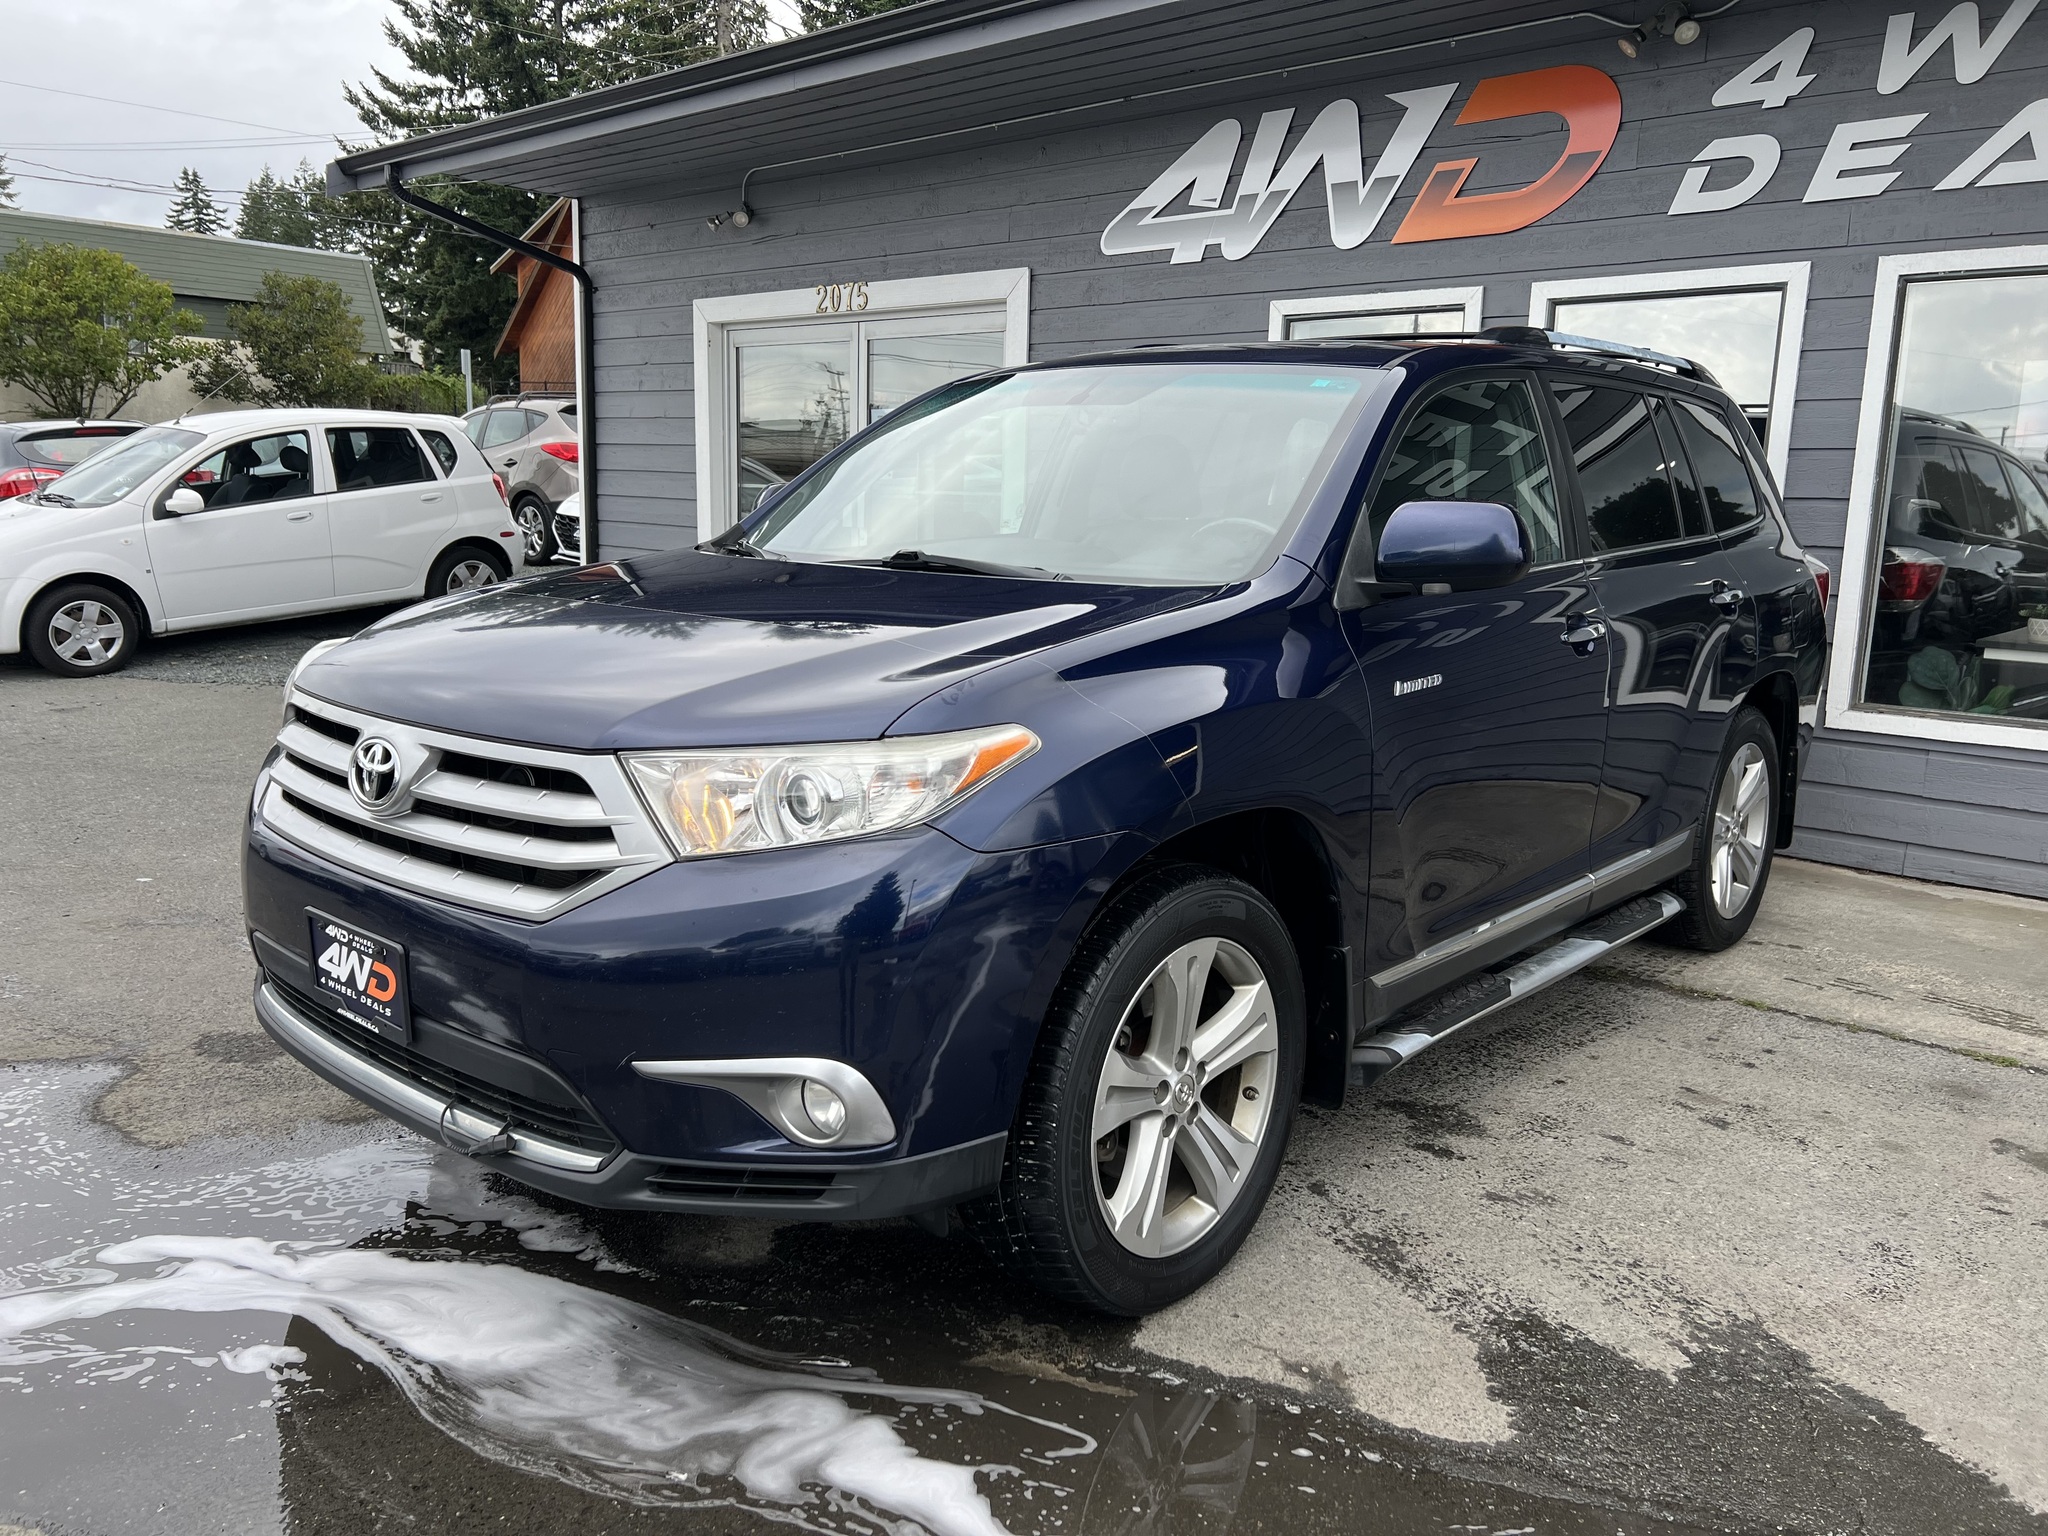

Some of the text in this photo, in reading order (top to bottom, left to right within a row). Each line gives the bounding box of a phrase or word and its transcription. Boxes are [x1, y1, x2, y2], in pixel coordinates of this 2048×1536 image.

[1710, 27, 1817, 109] 4
[1100, 64, 1623, 265] 4WD
[816, 281, 868, 313] 2075
[325, 924, 349, 943] 4WD
[352, 941, 373, 954] DEALS
[354, 935, 375, 949] WHEEL
[318, 942, 397, 1002] 4WD
[320, 976, 392, 1017] 4 WHEEL DEALS
